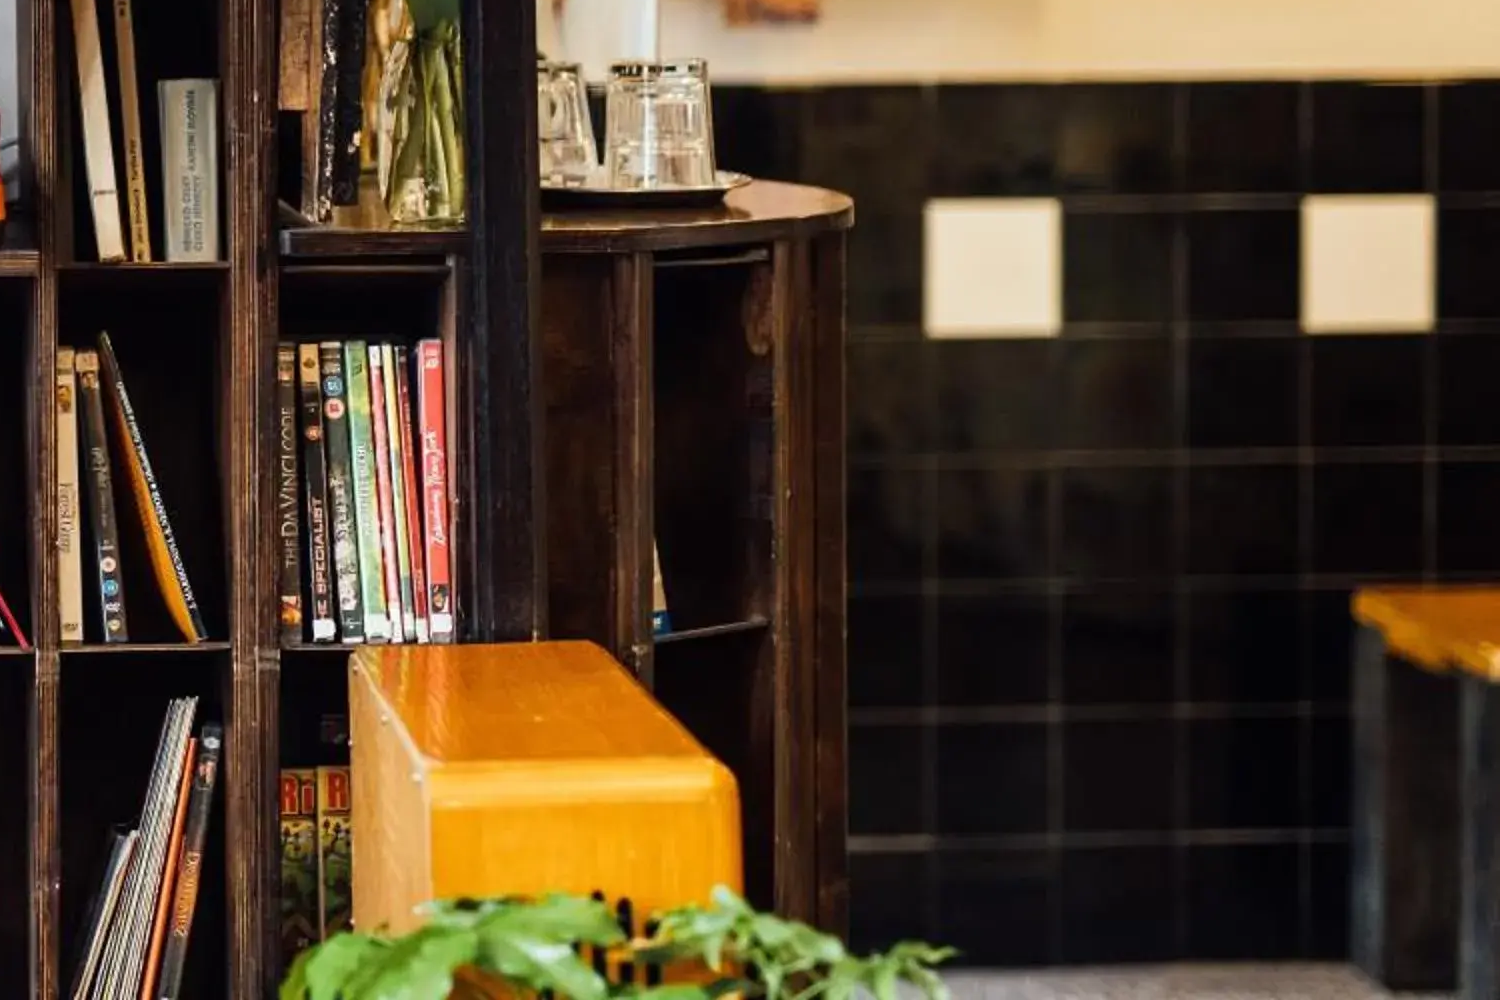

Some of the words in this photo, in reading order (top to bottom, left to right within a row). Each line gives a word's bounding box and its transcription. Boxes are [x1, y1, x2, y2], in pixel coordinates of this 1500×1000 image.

[282, 406, 295, 450] CODE
[280, 453, 296, 507] VINCI
[285, 538, 297, 568] THE
[315, 497, 327, 596] SPECIALIST
